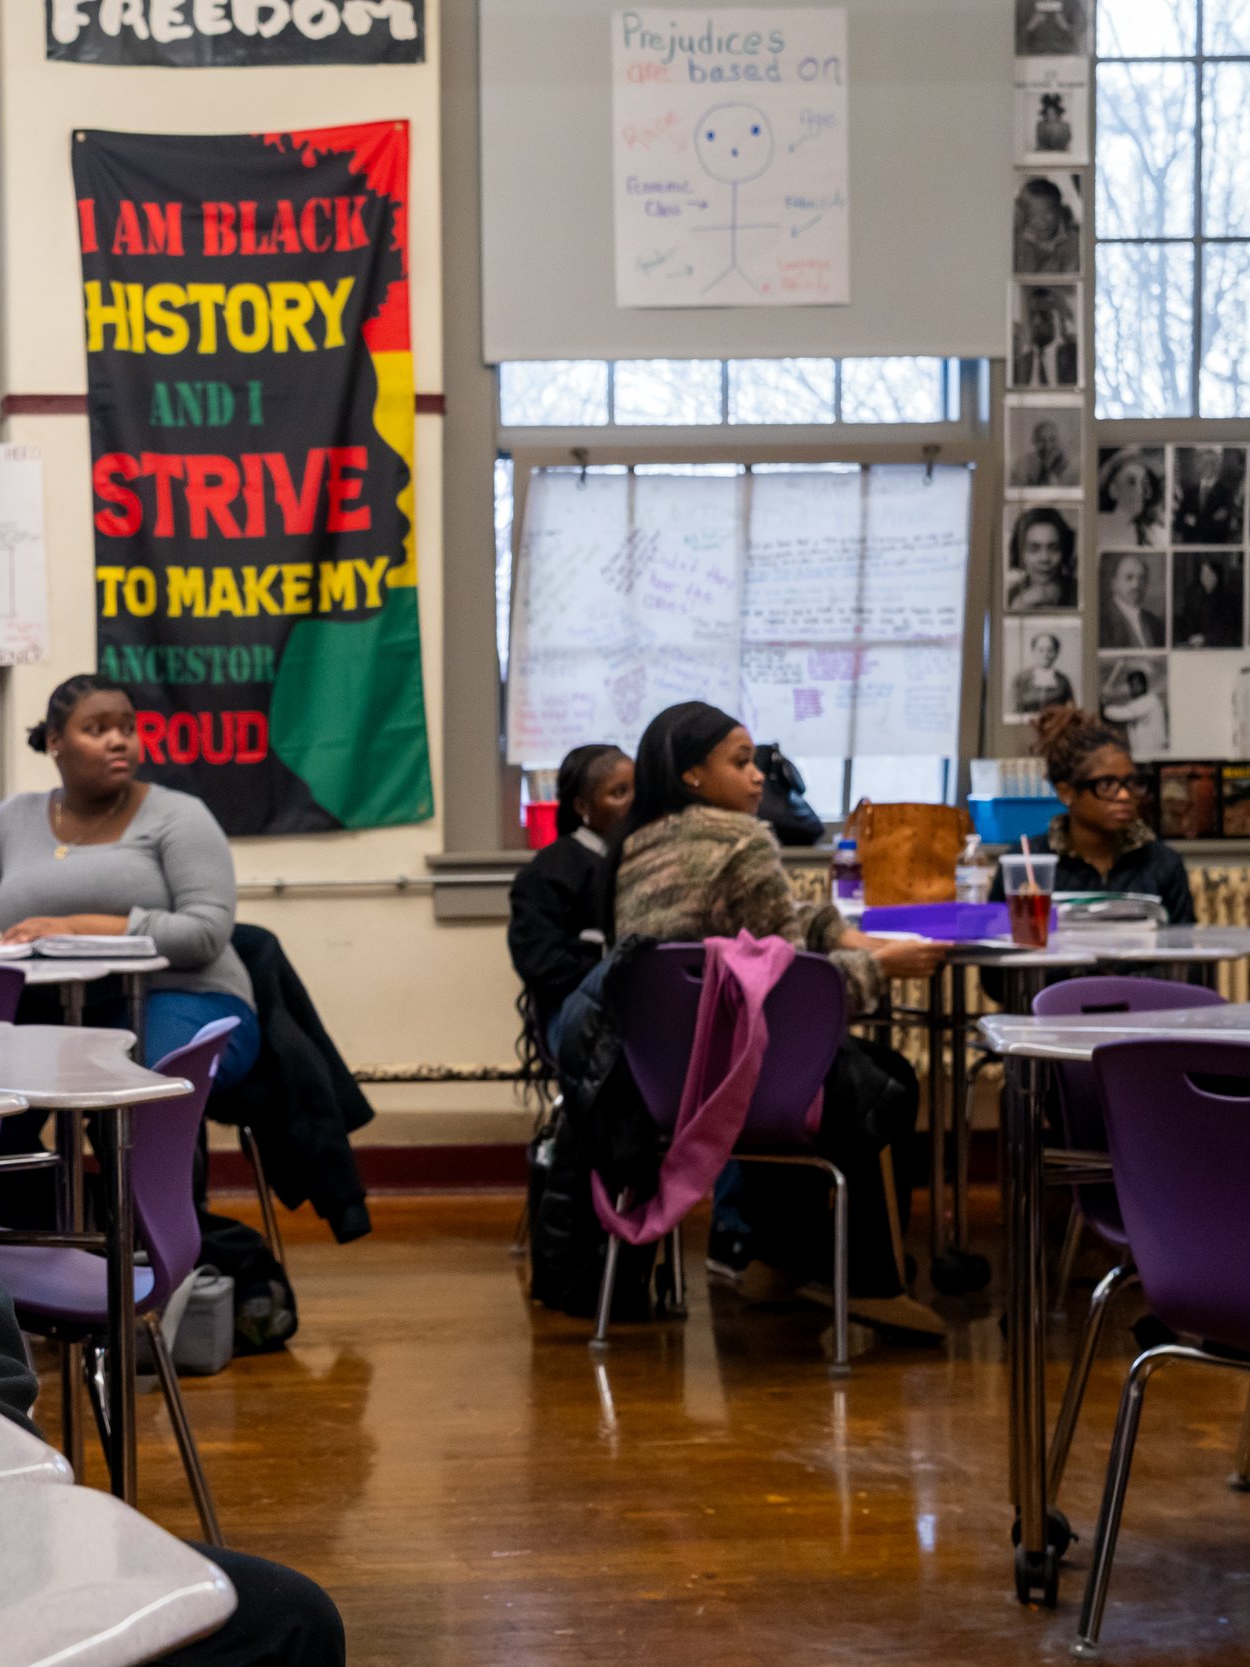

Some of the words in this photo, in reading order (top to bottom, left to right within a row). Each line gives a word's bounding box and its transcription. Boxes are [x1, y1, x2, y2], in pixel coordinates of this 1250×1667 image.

[52, 0, 418, 43] FREEDOM
[622, 11, 786, 65] Prejudices
[626, 62, 671, 84] are
[688, 57, 783, 83] based
[797, 55, 843, 86] on
[77, 198, 98, 255] I
[112, 198, 185, 257] AM
[202, 194, 370, 257] BLACK
[83, 276, 356, 355] HISTORY
[151, 381, 236, 427] AND
[245, 381, 266, 426] I
[92, 446, 371, 540] STRIVE
[96, 564, 157, 617] TO
[166, 561, 315, 618] MAKE
[319, 555, 392, 613] MY
[101, 643, 277, 685] ANCESTOR
[138, 710, 269, 765] ROUD
